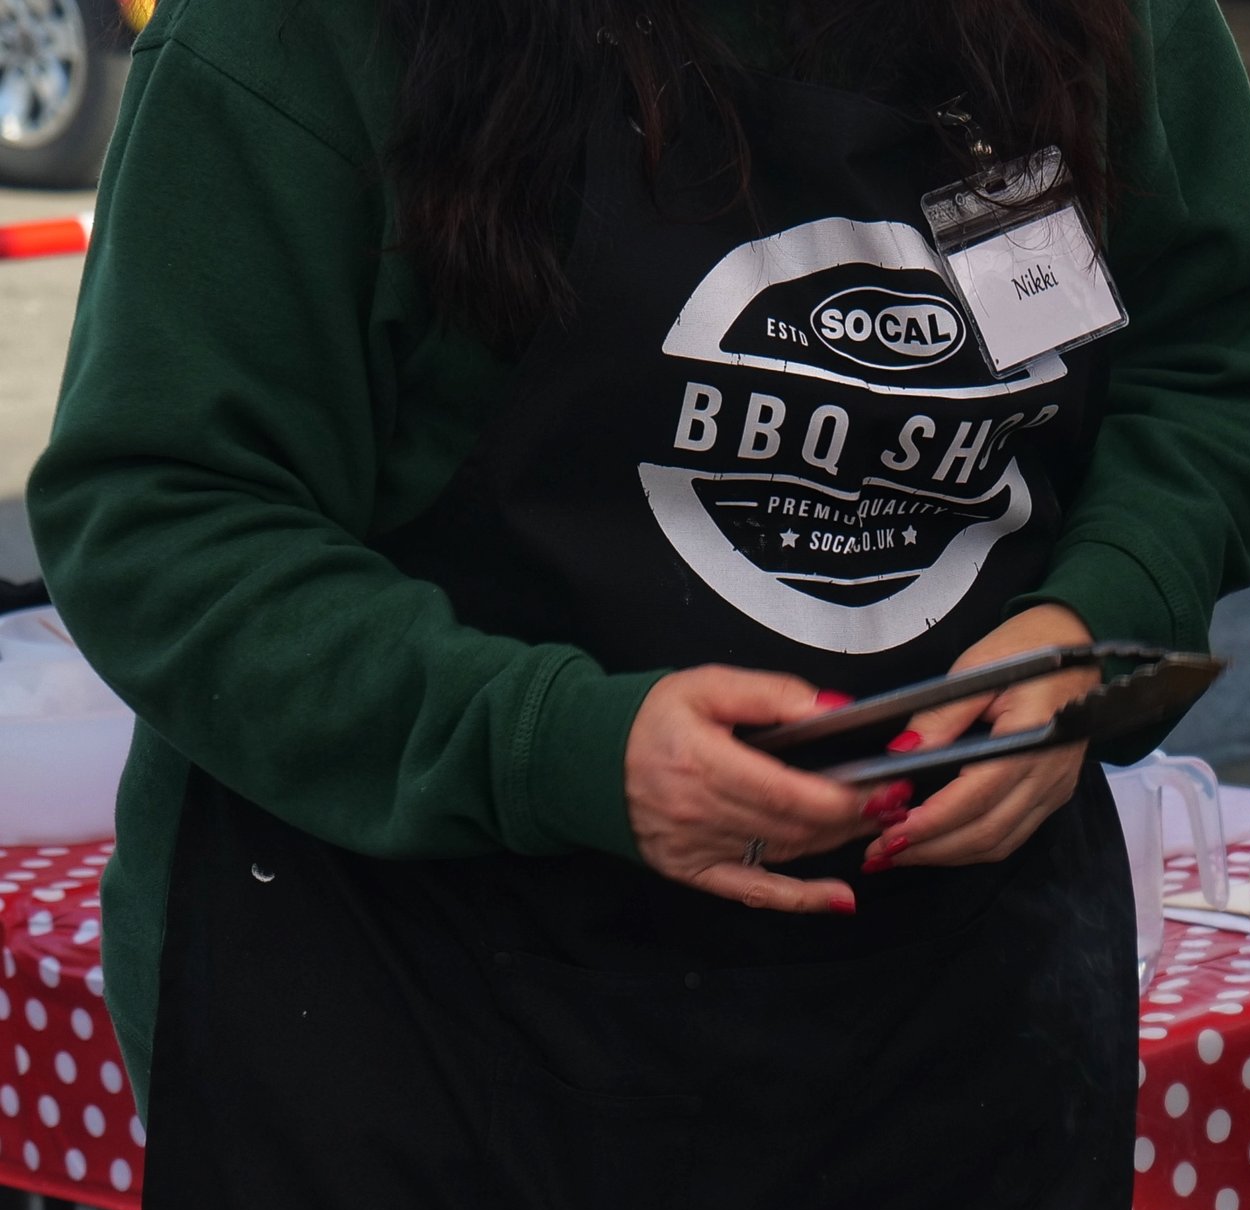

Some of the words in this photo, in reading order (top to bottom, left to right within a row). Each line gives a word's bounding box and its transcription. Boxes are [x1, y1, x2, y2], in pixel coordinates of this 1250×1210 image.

[1011, 264, 1059, 301] Nikki
[766, 317, 809, 347] ESTD
[820, 308, 952, 346] SOCAL
[673, 381, 850, 476] BBQ
[856, 498, 948, 527] QUALITY
